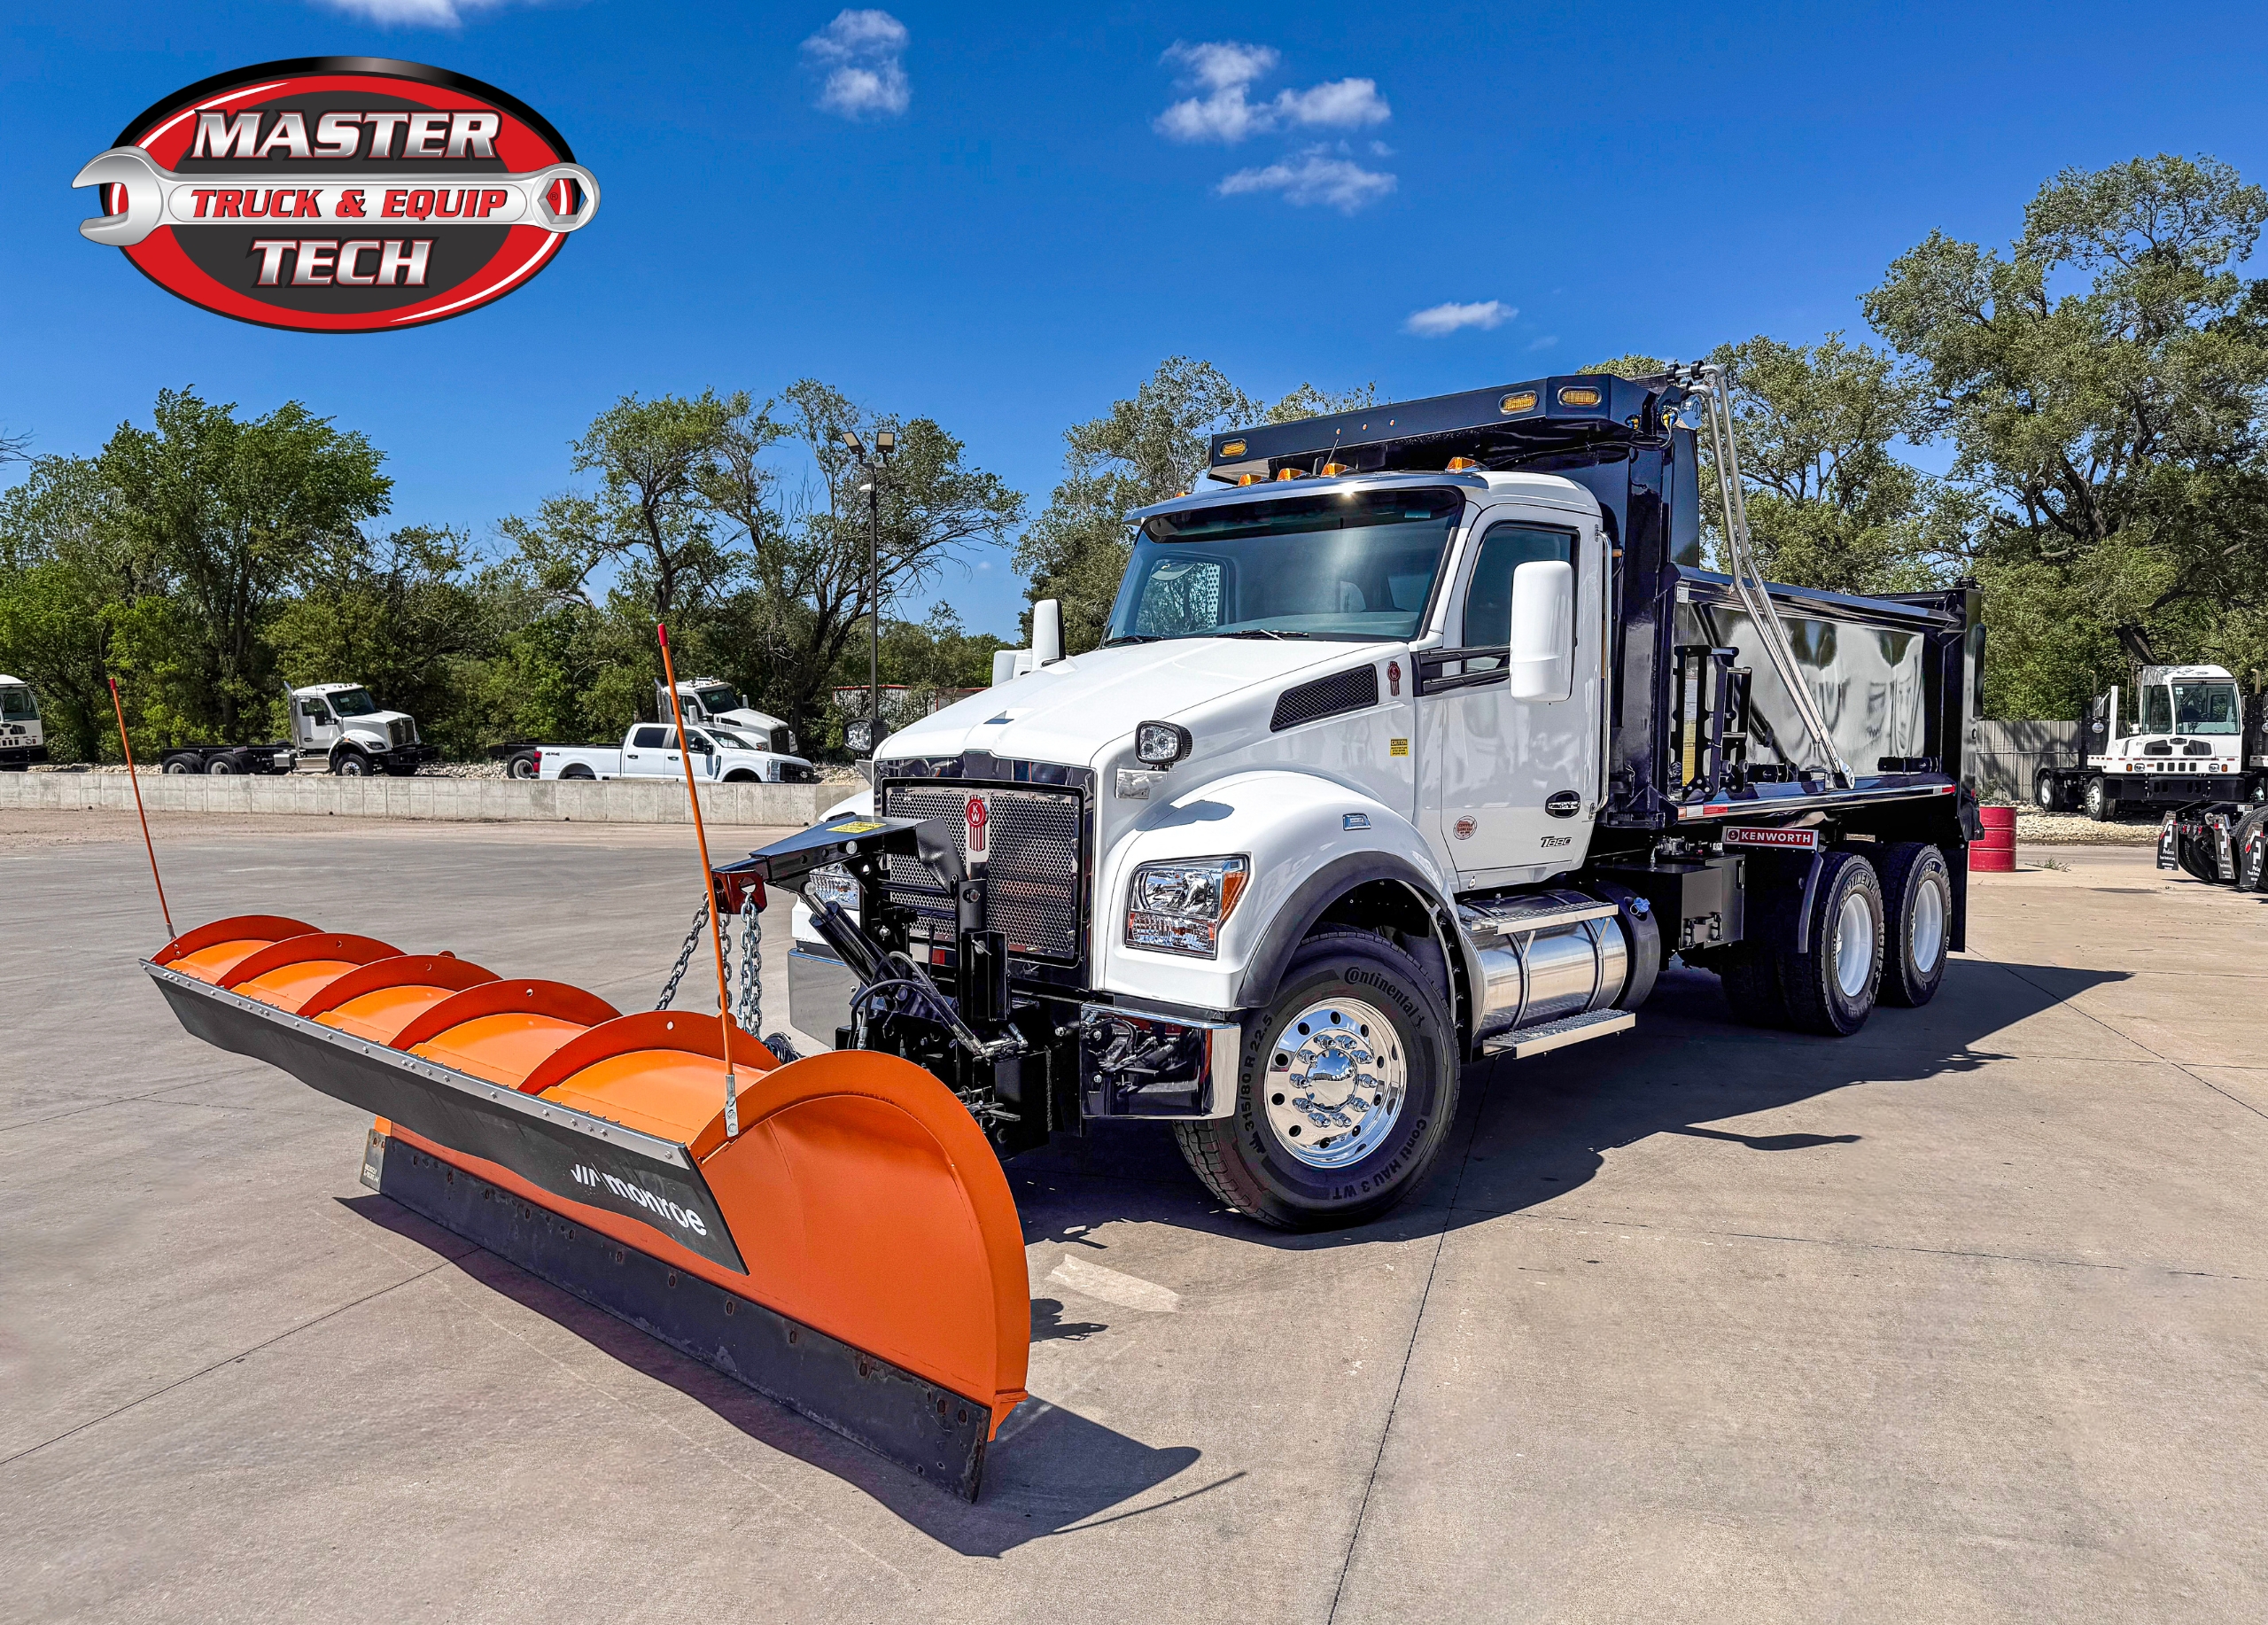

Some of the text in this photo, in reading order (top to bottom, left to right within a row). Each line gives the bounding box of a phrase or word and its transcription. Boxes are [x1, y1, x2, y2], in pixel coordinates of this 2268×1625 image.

[1540, 836, 1573, 848] T880
[1741, 831, 1811, 844] KENWORTH
[1344, 966, 1419, 1018] Continental
[1244, 1055, 1255, 1069] R
[1250, 1015, 1273, 1053] 22.5
[1400, 1118, 1427, 1161] Conti
[602, 1171, 707, 1236] monroe
[1332, 1185, 1357, 1200] WT
